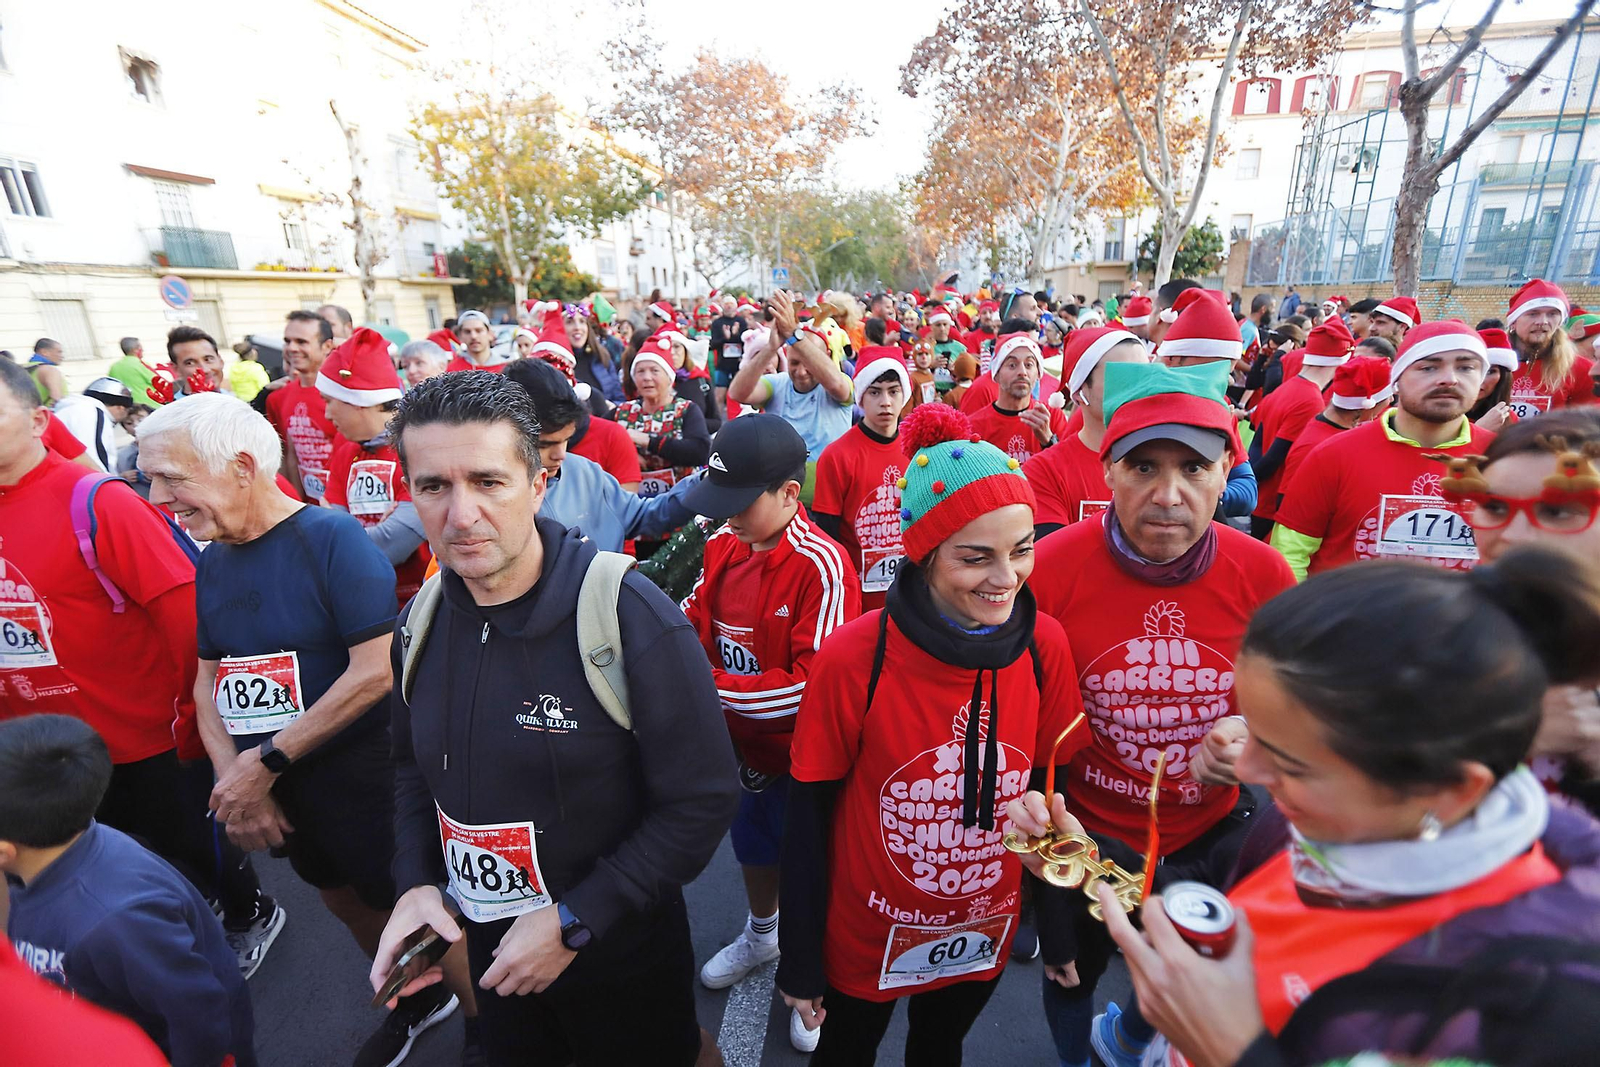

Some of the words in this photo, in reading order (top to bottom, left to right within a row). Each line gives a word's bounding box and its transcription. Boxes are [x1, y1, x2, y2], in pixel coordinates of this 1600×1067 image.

[643, 481, 659, 494] 39
[1407, 512, 1456, 538] 171
[879, 559, 902, 577] 19
[1124, 638, 1200, 667] XIII
[37, 686, 79, 698] HUELVA
[1085, 665, 1234, 693] CARRERA
[222, 678, 270, 710] 182
[881, 796, 935, 820] SAN
[883, 810, 915, 840] DE
[887, 833, 925, 862] 30
[925, 851, 949, 866] DE
[451, 844, 503, 892] 448
[912, 861, 1003, 895] 2023
[867, 891, 947, 926] Huelva
[928, 936, 967, 966] 60
